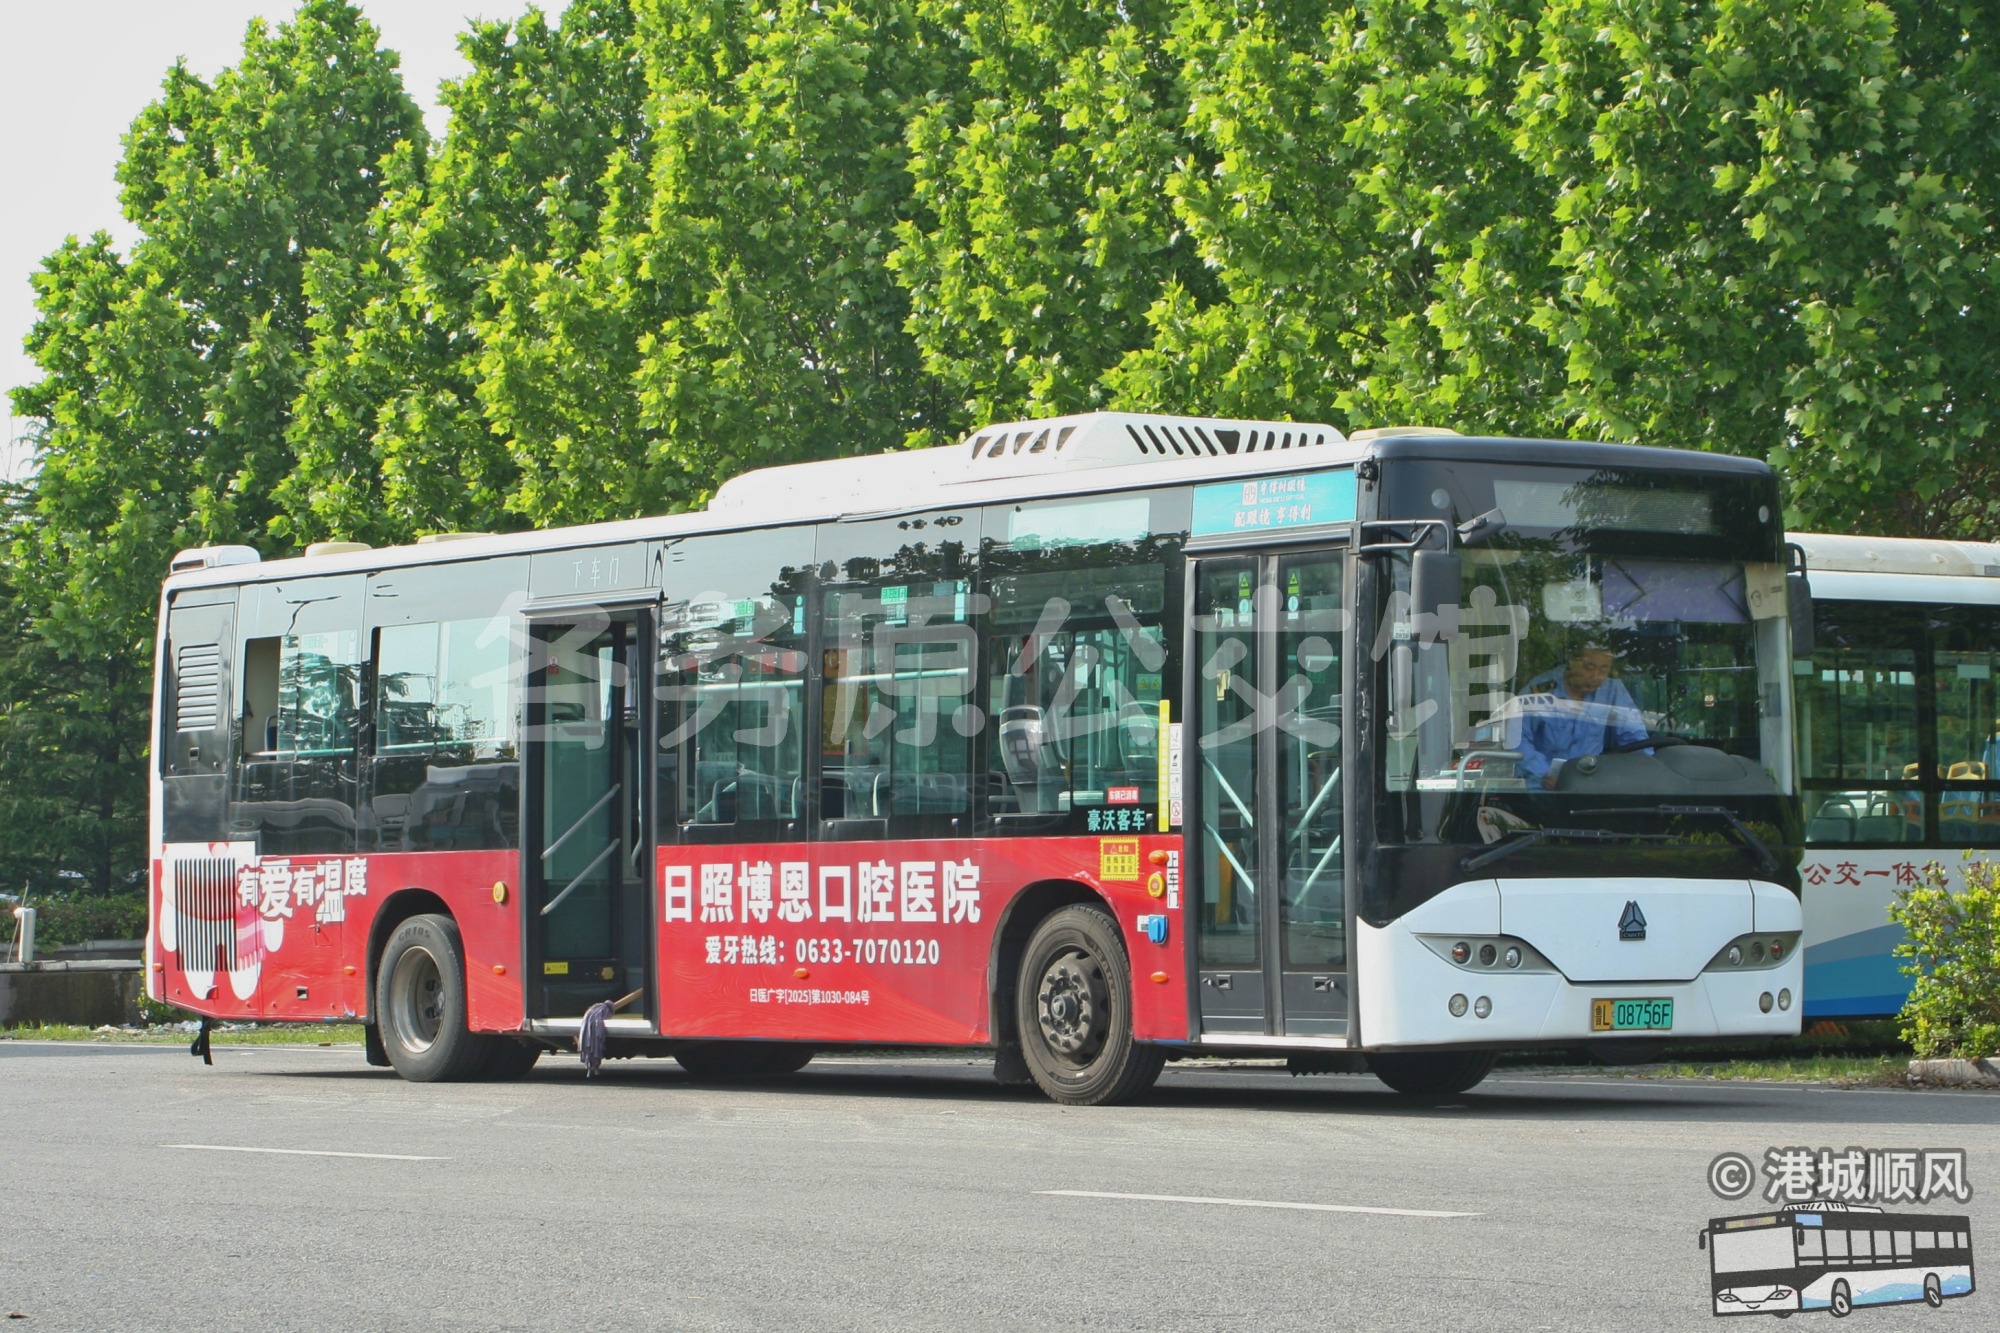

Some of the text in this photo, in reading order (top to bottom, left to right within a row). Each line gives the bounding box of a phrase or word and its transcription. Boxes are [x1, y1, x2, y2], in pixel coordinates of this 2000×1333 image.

[573, 556, 619, 588] 下车门
[1087, 808, 1146, 831] 豪沃客车
[237, 857, 368, 923] 有爱有温度
[664, 858, 981, 924] 日照博恩口腔医院
[1168, 851, 1179, 907] 上车门
